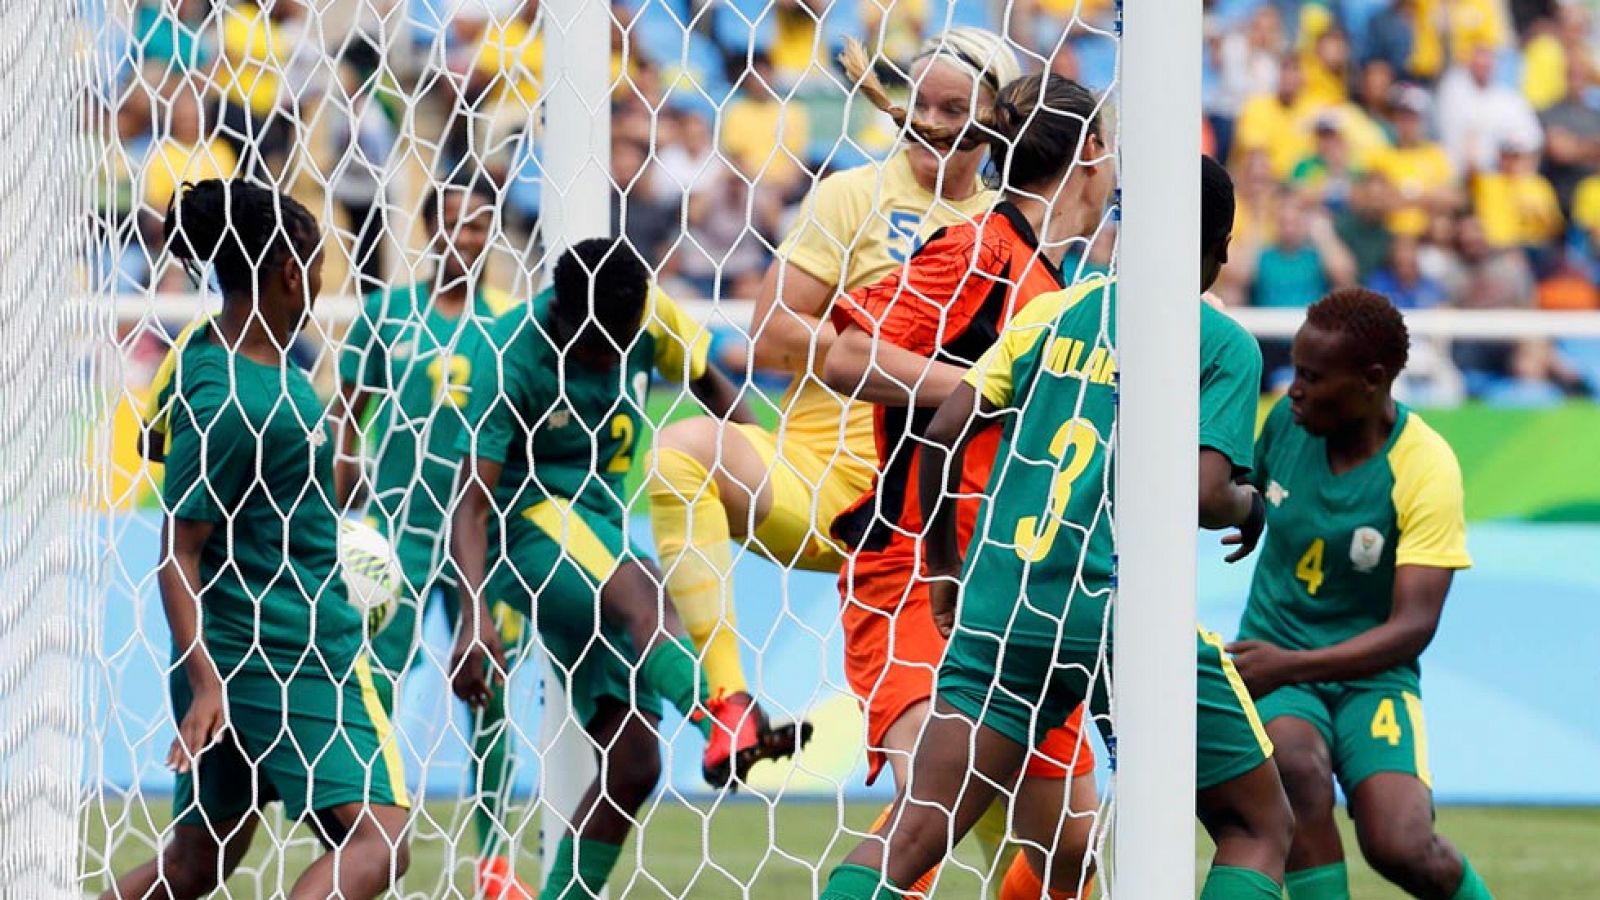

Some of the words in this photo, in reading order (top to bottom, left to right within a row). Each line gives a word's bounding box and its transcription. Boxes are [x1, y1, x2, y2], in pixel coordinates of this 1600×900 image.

[888, 211, 922, 263] 5
[606, 414, 634, 472] 2
[1014, 418, 1097, 562] 3
[1296, 538, 1324, 595] 4
[1371, 698, 1401, 746] 4
